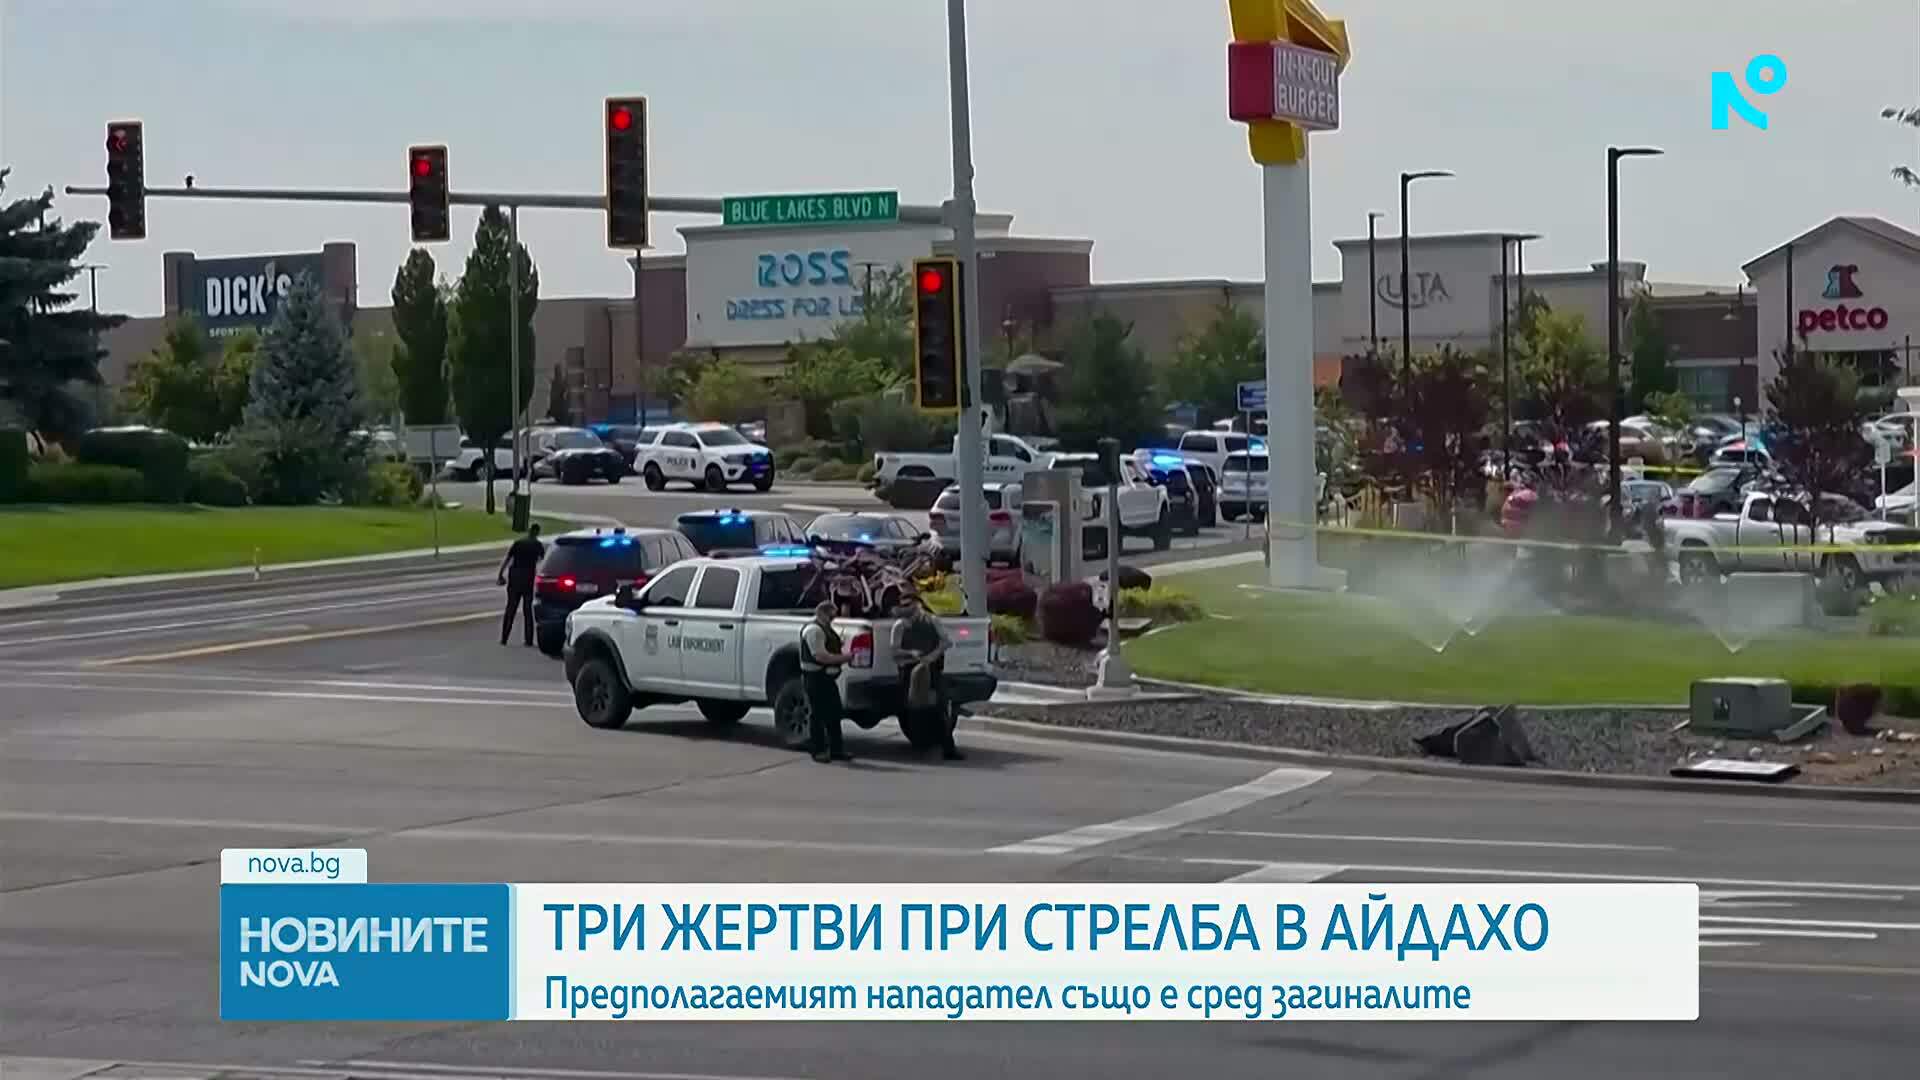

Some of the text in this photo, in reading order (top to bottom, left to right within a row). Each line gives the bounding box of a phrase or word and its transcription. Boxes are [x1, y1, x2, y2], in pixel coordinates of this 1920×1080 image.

[1277, 48, 1336, 89] IN-N-OUT
[1278, 83, 1337, 123] BURGER
[732, 195, 890, 222] BLUE LAKES BLVD N
[757, 249, 850, 289] ROSS
[1798, 303, 1889, 338] petco
